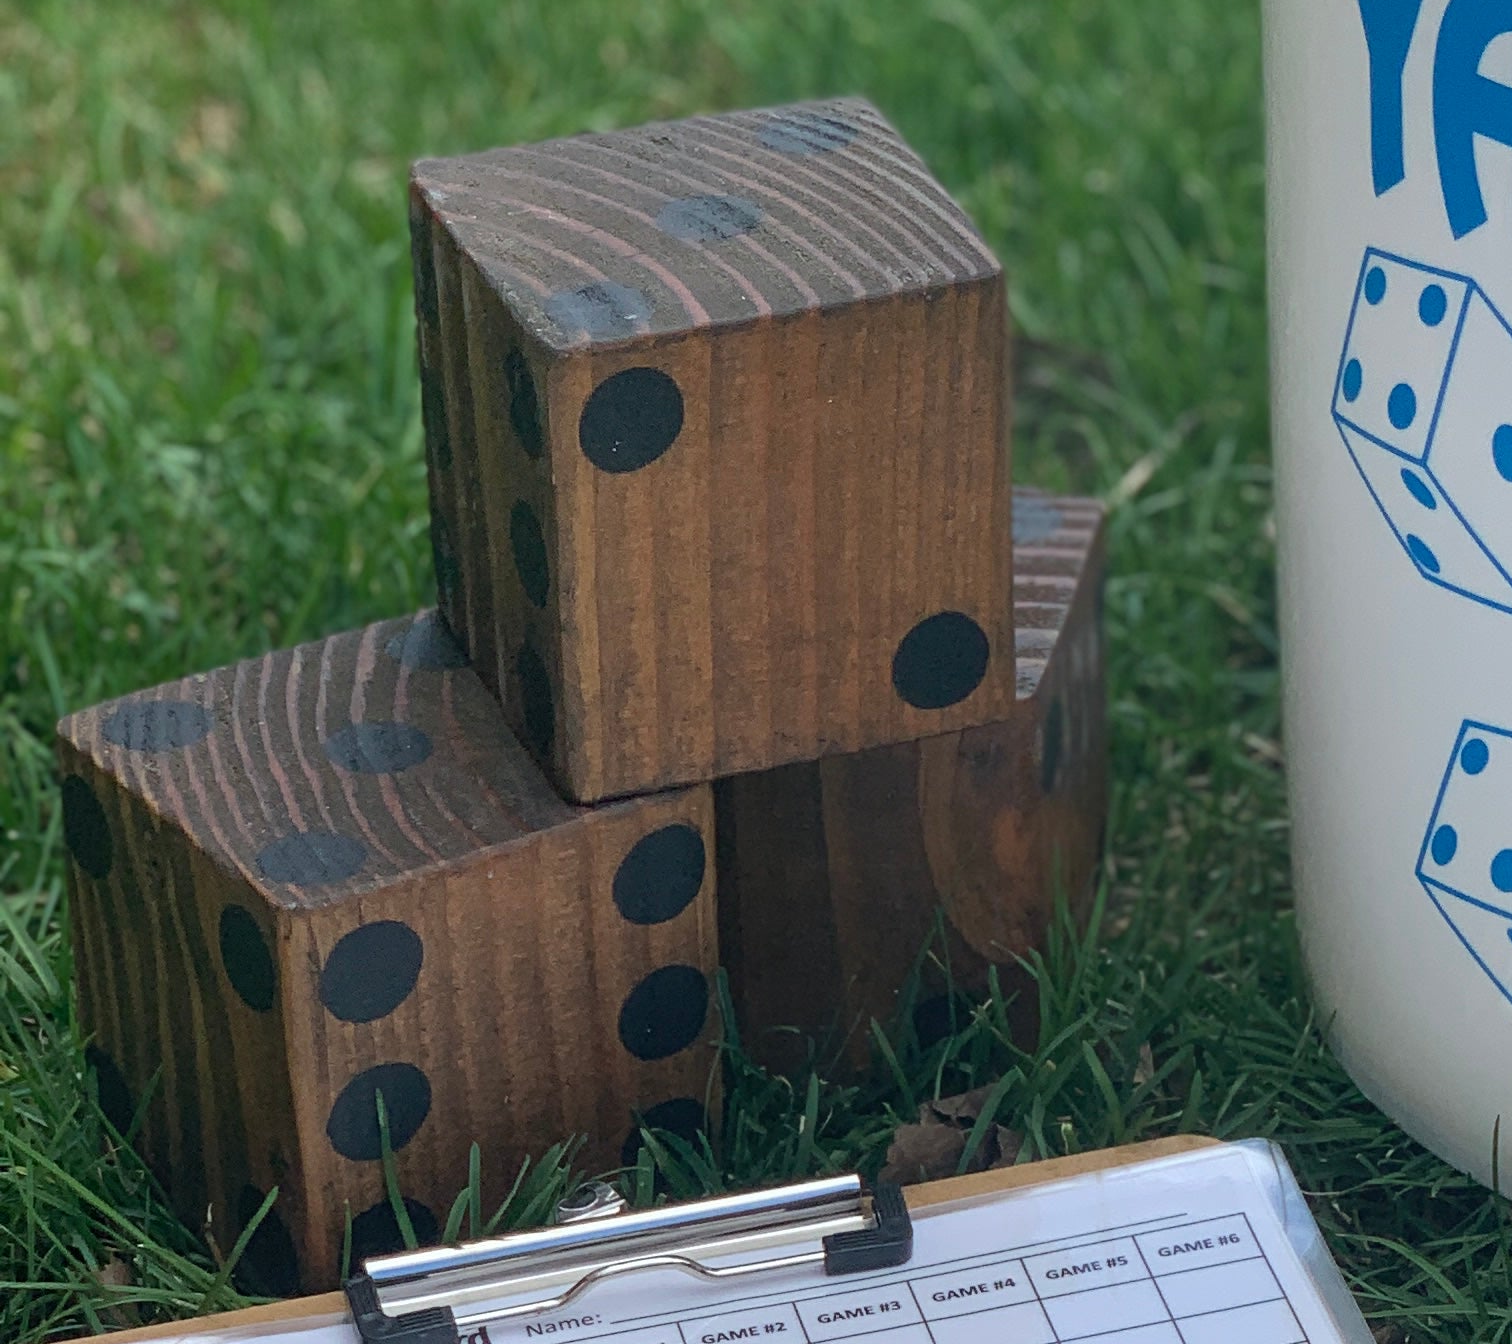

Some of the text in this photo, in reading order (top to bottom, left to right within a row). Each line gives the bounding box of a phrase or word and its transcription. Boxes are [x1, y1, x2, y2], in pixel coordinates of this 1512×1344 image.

[1157, 1232, 1242, 1258] GAME #6
[1046, 1256, 1128, 1280] GAME #5
[932, 1278, 1016, 1302] GAME #4
[817, 1301, 902, 1324] GAME #3
[525, 1314, 602, 1336] Name:
[701, 1322, 788, 1344] GAME #2
